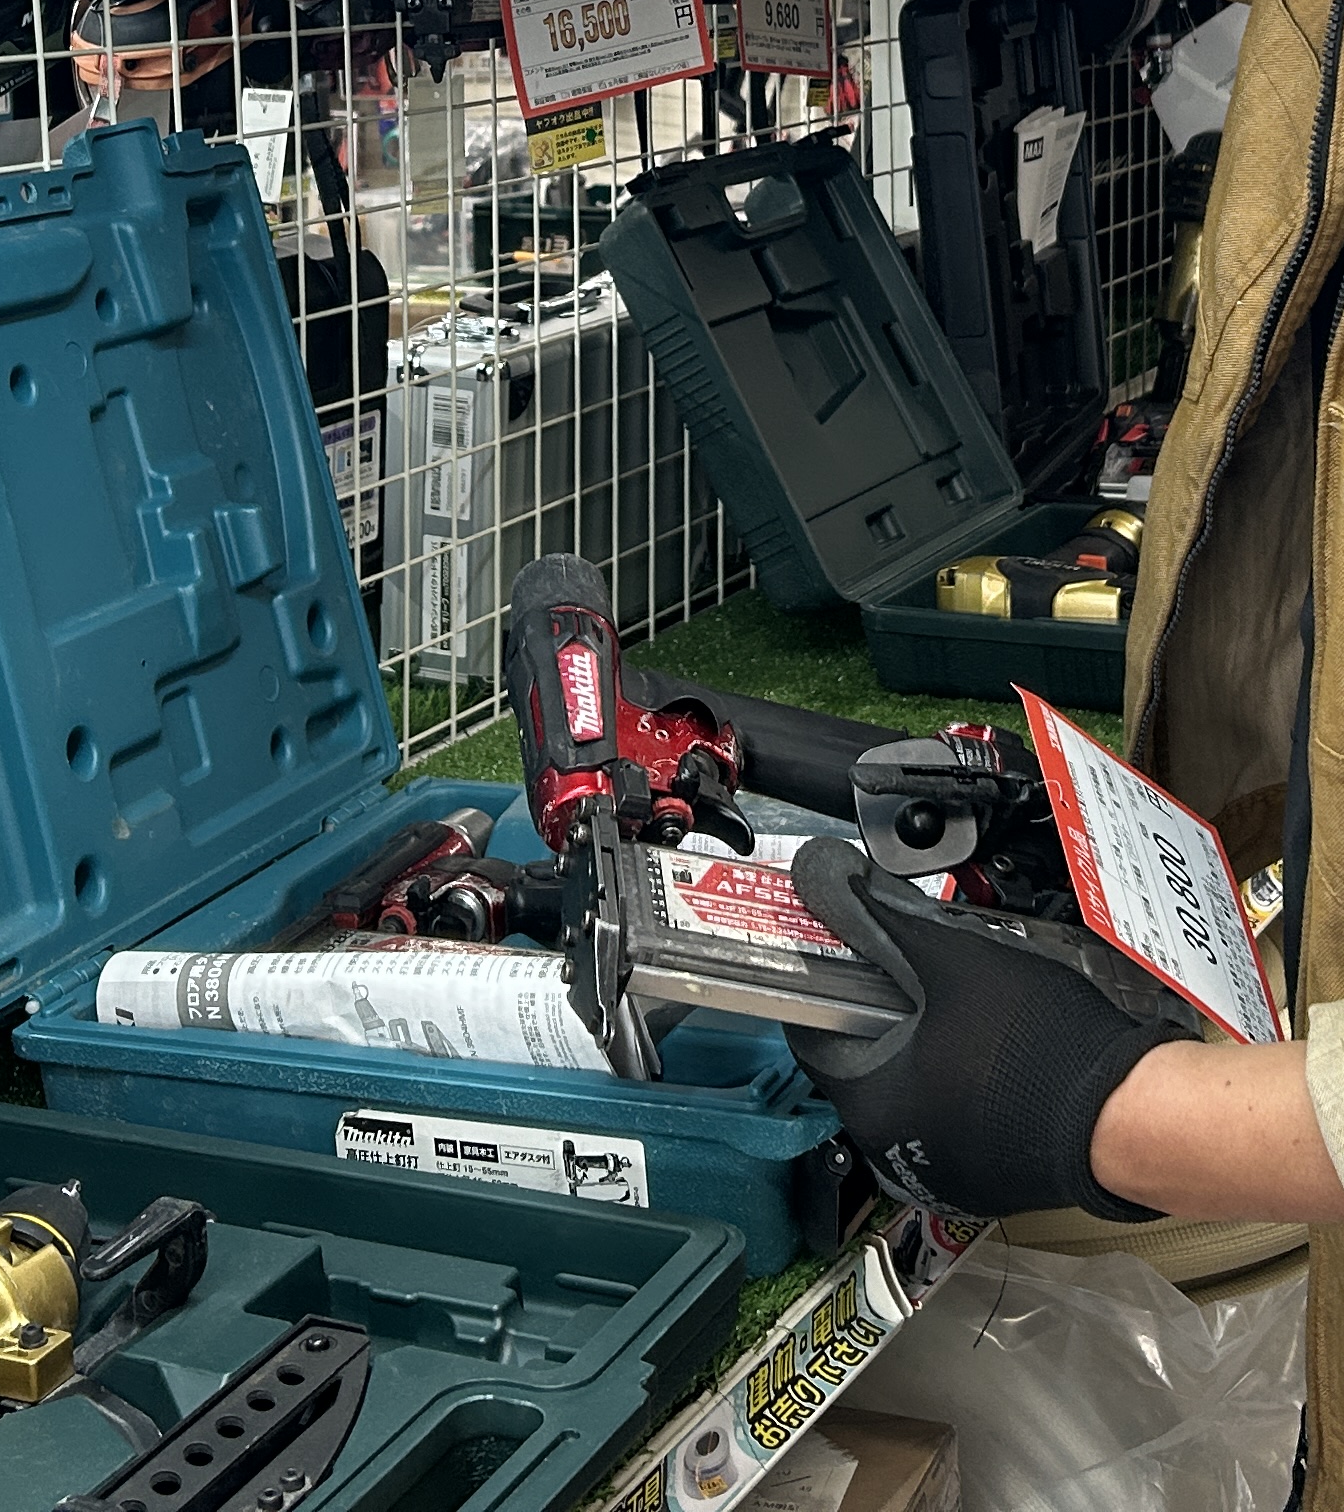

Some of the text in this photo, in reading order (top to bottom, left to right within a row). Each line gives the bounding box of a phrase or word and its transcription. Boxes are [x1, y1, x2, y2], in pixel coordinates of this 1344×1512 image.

[674, 4, 695, 28] 円
[765, 0, 800, 31] 9,680
[1144, 785, 1173, 820] 円
[1067, 826, 1111, 929] リサイクル品
[1152, 832, 1218, 966] 30,800
[503, 1150, 551, 1166] エアダスタ付
[747, 1270, 857, 1424] 建材・電材
[750, 1316, 887, 1450] お売り下さい
